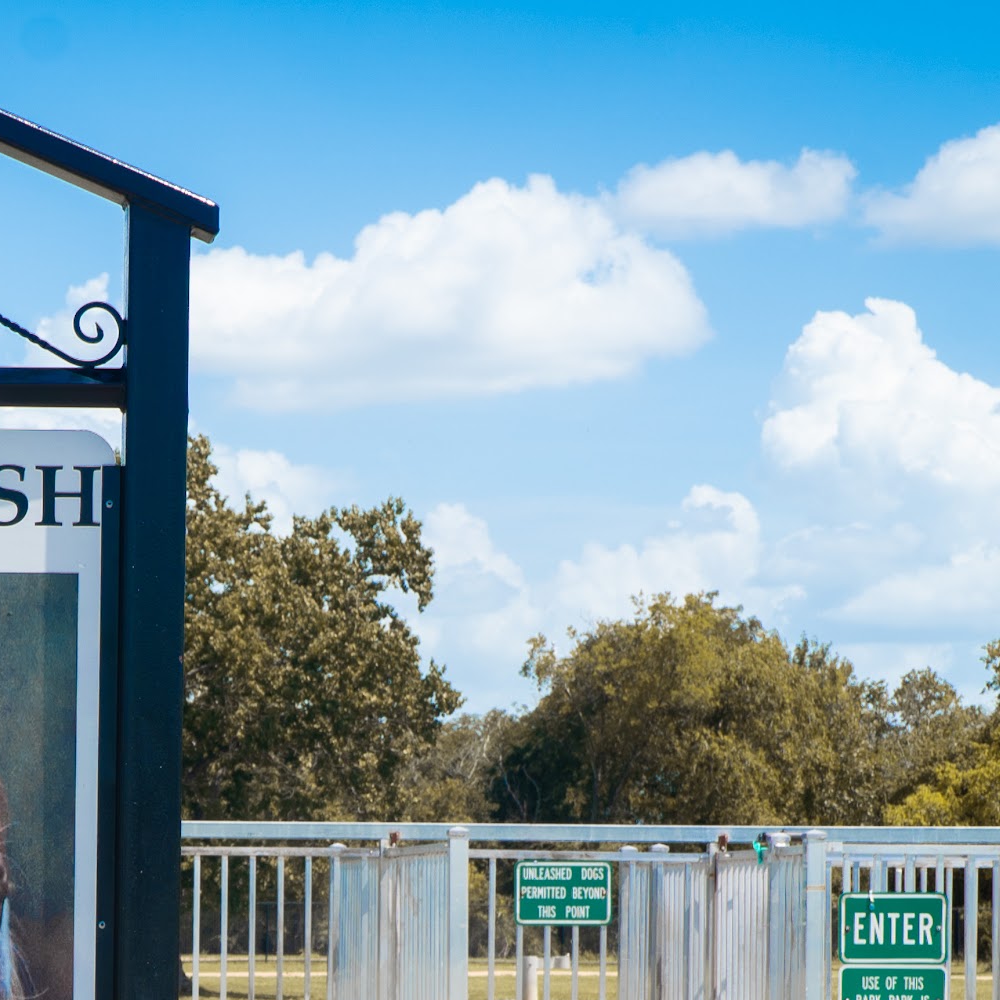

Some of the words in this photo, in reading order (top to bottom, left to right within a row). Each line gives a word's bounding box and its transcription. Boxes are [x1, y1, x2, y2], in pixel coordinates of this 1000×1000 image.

[522, 867, 572, 880] UNLEASHED
[581, 867, 604, 880] DOGS
[521, 886, 566, 899] PERMITTED
[572, 886, 606, 899] BEYOND
[537, 905, 556, 918] THIS
[565, 905, 590, 918] POINT
[853, 912, 934, 945] ENTER
[861, 976, 880, 990] USE
[885, 976, 898, 990] OF
[903, 976, 924, 990] THIS
